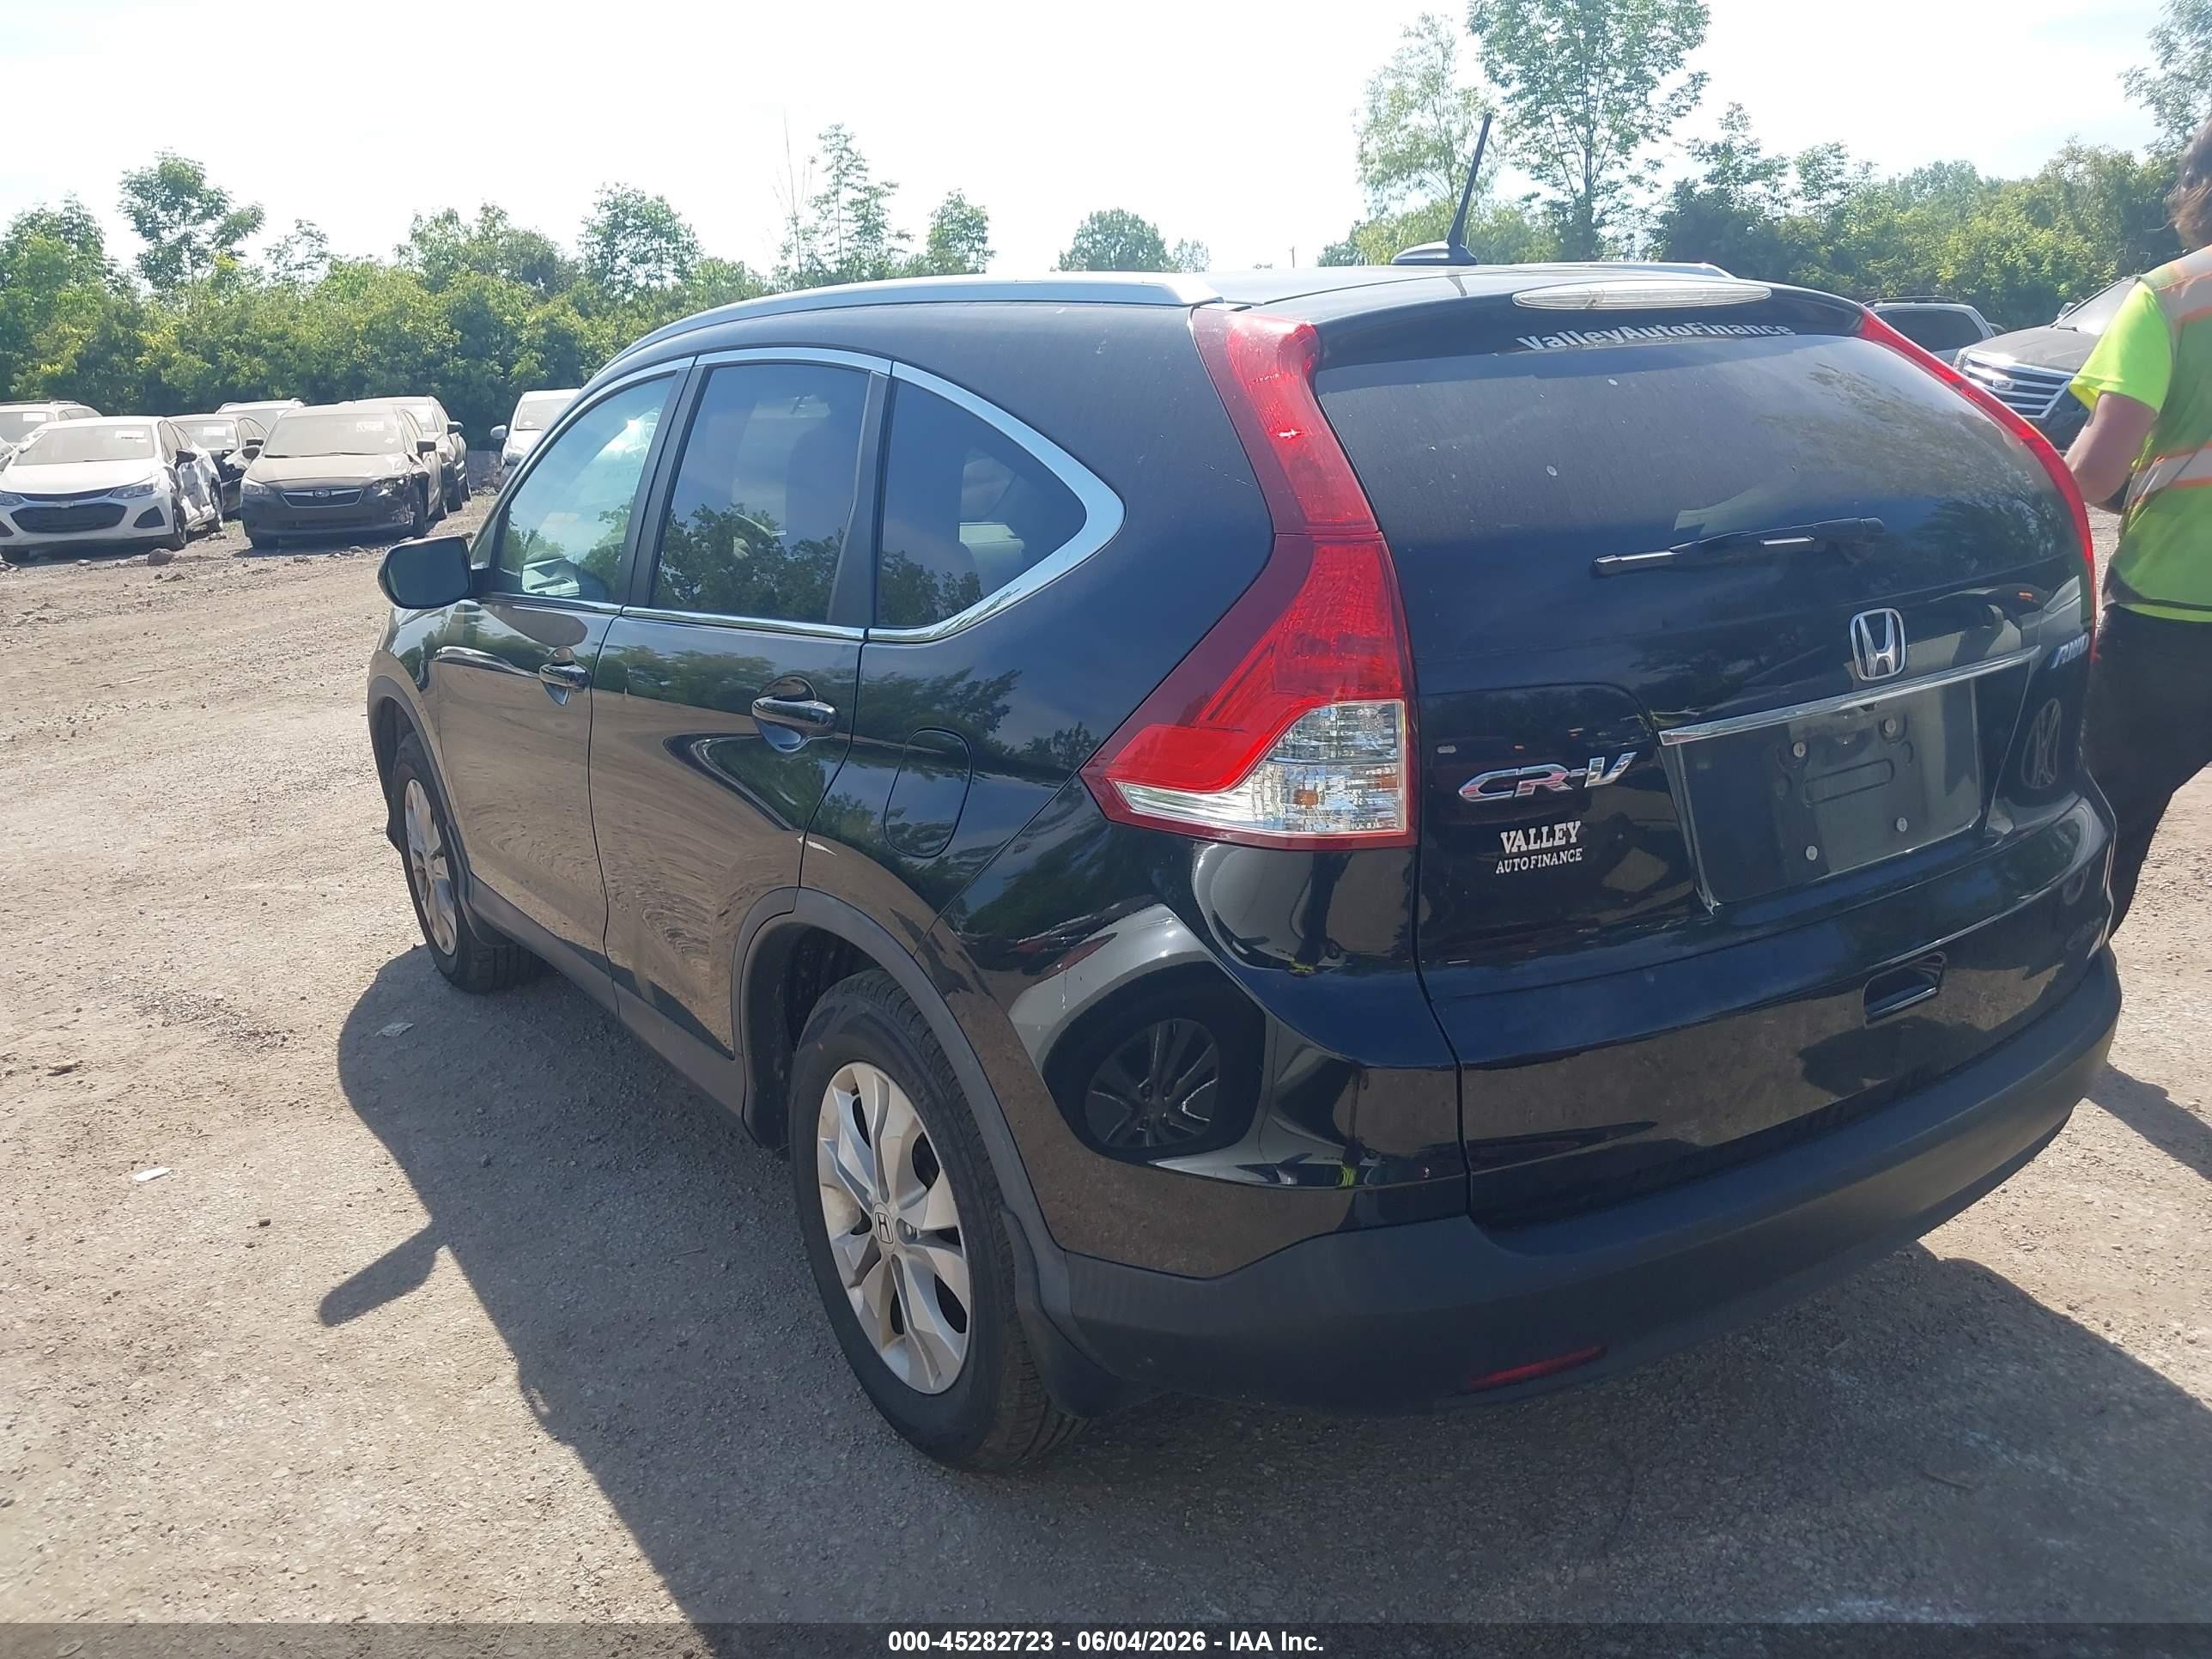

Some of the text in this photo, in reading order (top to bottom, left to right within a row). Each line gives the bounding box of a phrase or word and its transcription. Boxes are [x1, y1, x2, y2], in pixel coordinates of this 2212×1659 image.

[1516, 322, 1796, 350] ValleyAutoFinance
[2051, 632, 2089, 670] AWD
[1459, 751, 1638, 802] CR-V
[1500, 820, 1582, 854] VALLEY
